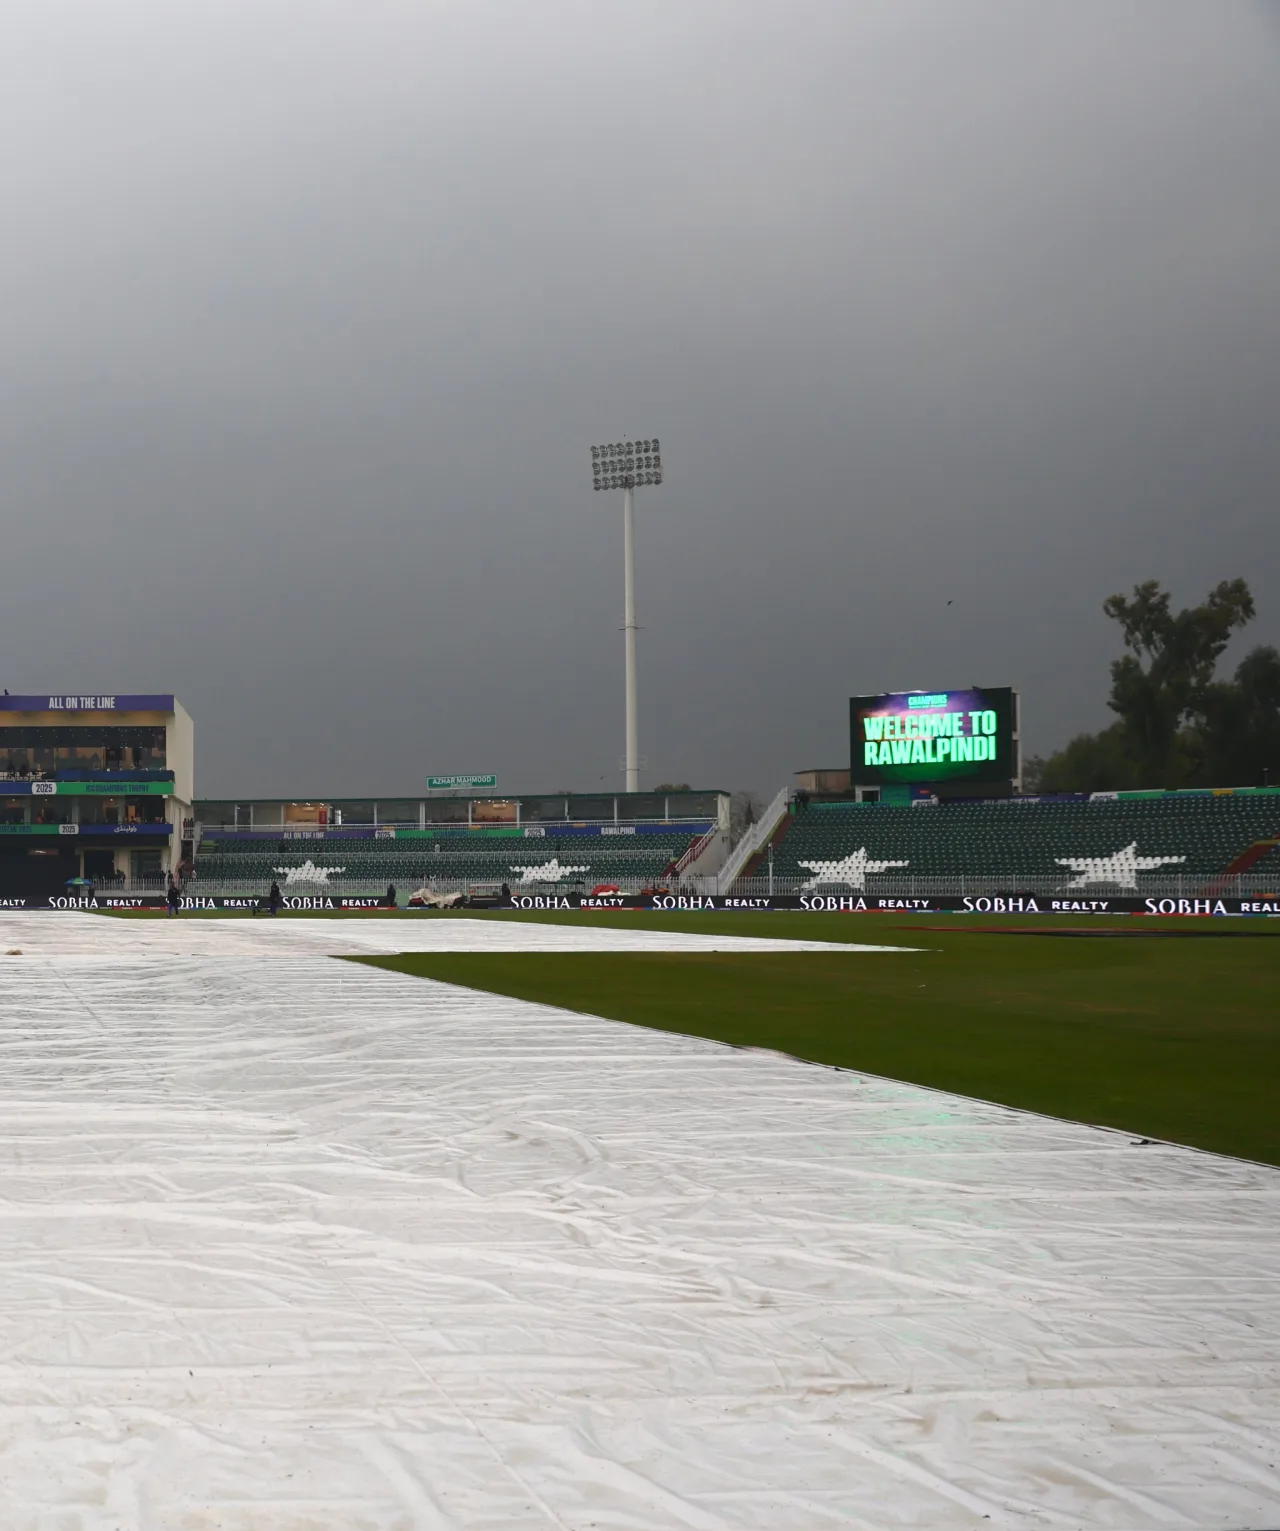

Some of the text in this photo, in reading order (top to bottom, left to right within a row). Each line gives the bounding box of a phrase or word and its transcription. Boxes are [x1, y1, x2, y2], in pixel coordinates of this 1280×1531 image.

[48, 696, 64, 709] ALL
[66, 696, 78, 709] ON
[80, 696, 95, 709] THE
[97, 696, 116, 709] LINE
[864, 709, 997, 740] WELCOME TO
[864, 736, 996, 765] RAWALPINDI
[432, 776, 492, 785] AZHAR MAHMOOD
[35, 783, 53, 793] 2025
[62, 825, 76, 834] 2025
[601, 827, 636, 836] RAWALPINDI
[48, 896, 99, 908] SOBHA
[281, 896, 333, 909] SOBHA
[510, 896, 624, 909] SOBHA REALTY
[652, 895, 770, 910] SOBHA REALTY
[799, 896, 930, 911] SOBHA REALTY
[962, 897, 1109, 912] SOBHA REALTY
[1144, 898, 1227, 914] SOBHA
